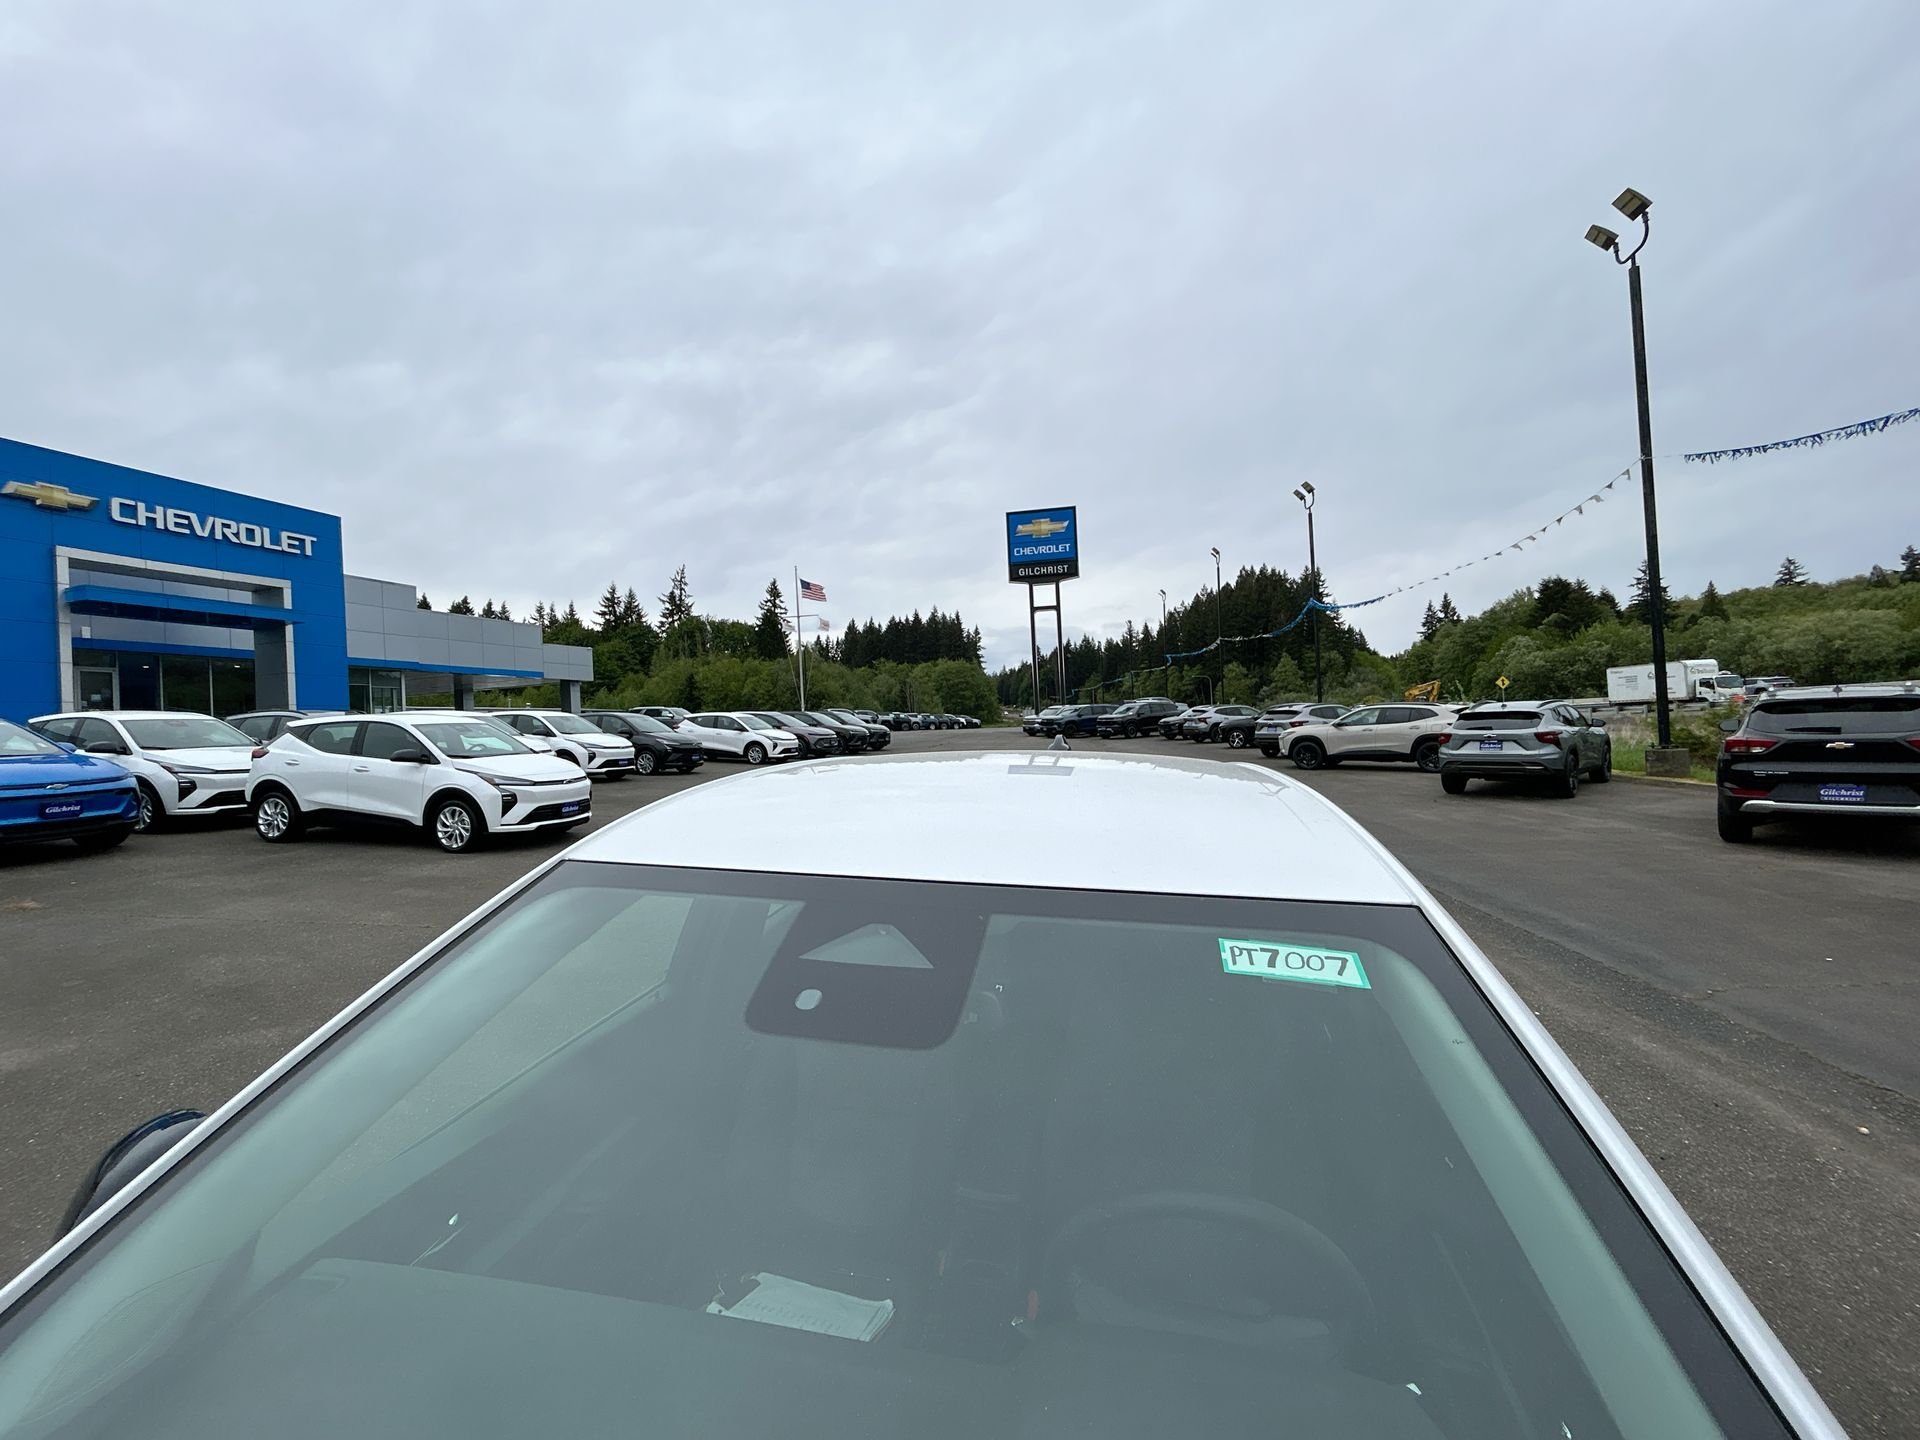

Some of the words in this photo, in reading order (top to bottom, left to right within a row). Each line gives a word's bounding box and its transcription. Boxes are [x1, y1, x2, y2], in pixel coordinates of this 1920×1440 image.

[111, 497, 317, 556] CHEVROLET
[1014, 543, 1070, 556] CHEVROLET
[1018, 564, 1069, 576] GILCHRIST
[1820, 788, 1865, 796] Gilchrist
[45, 805, 81, 814] Gilchrist
